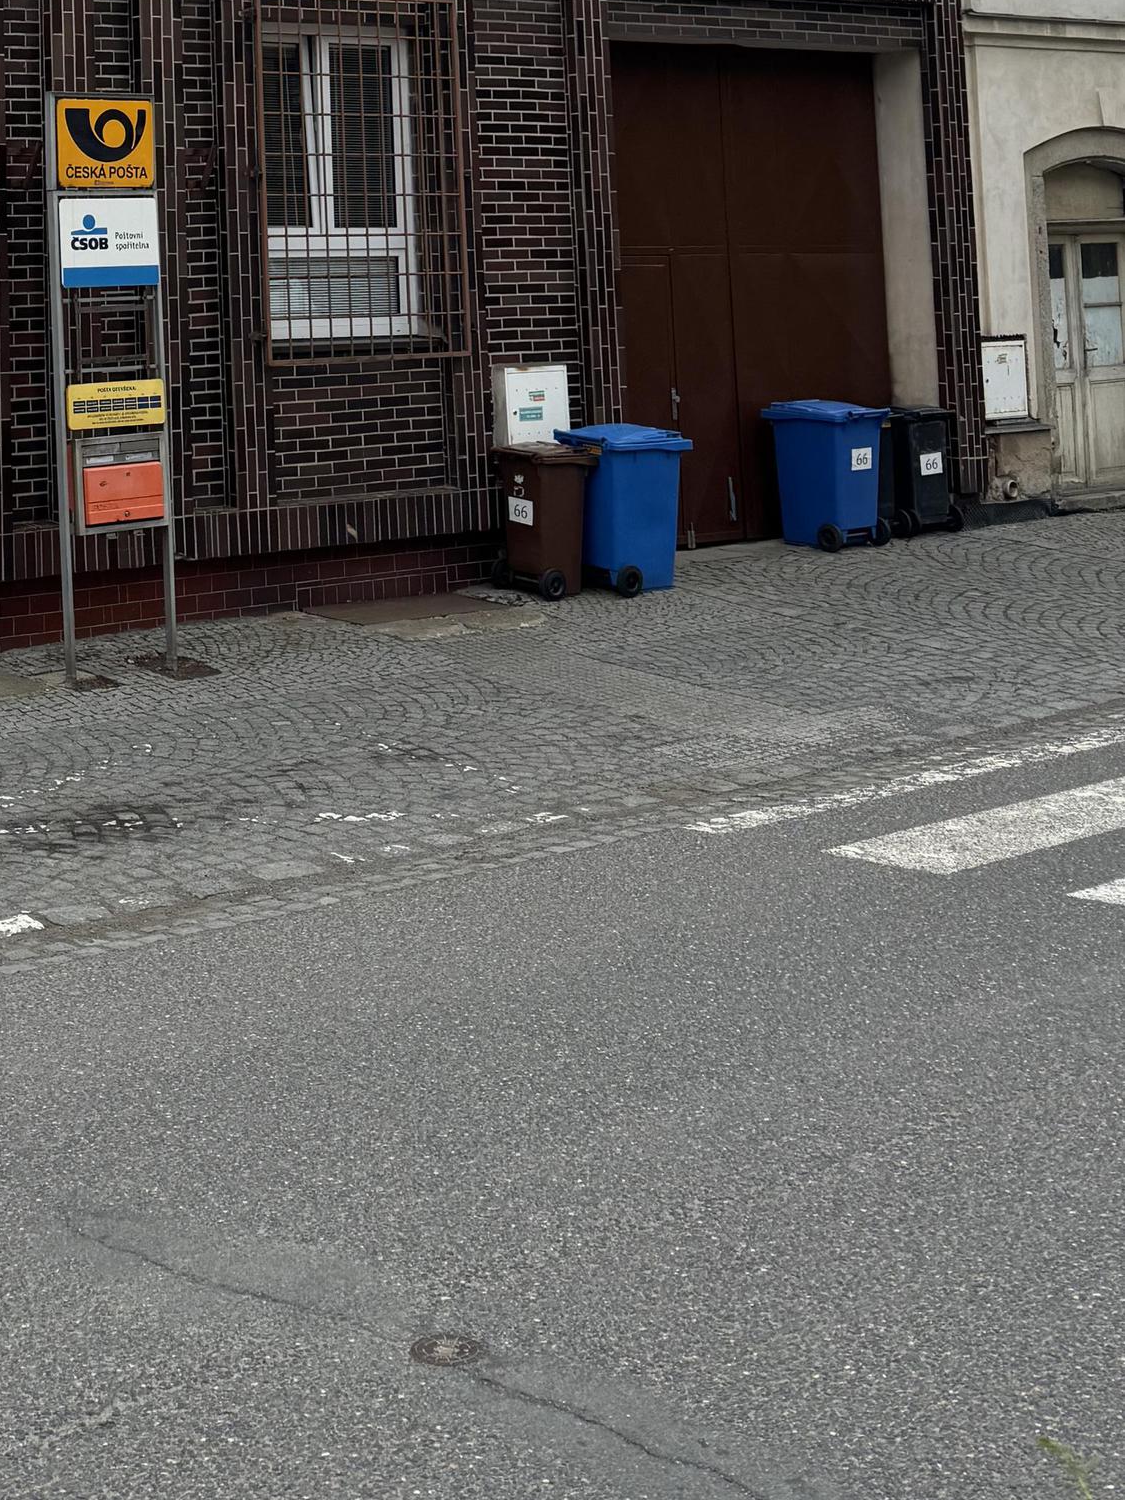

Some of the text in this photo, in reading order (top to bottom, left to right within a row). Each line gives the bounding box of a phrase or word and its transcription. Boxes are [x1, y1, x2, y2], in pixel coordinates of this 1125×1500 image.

[65, 163, 148, 179] ČESKÁ POŠTA
[70, 236, 109, 251] ČSOB
[856, 452, 868, 466] 66
[925, 458, 939, 471] 66
[513, 503, 528, 520] 66
